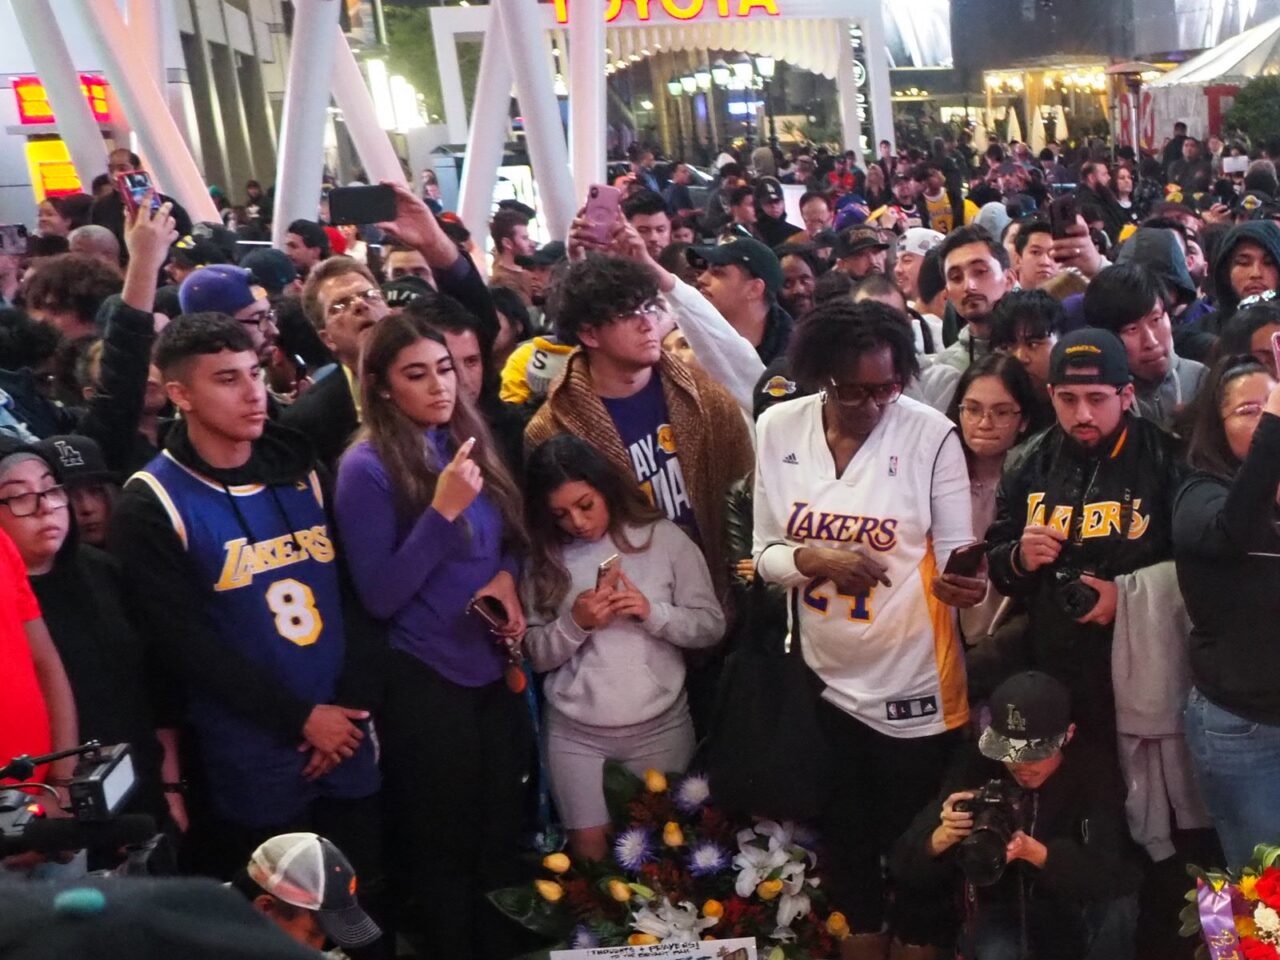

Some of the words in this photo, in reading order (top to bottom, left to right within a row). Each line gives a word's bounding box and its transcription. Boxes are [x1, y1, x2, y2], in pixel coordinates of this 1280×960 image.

[54, 440, 85, 467] LA
[785, 502, 898, 551] LAKERS
[214, 525, 335, 591] LAKERS
[265, 578, 323, 646] 8
